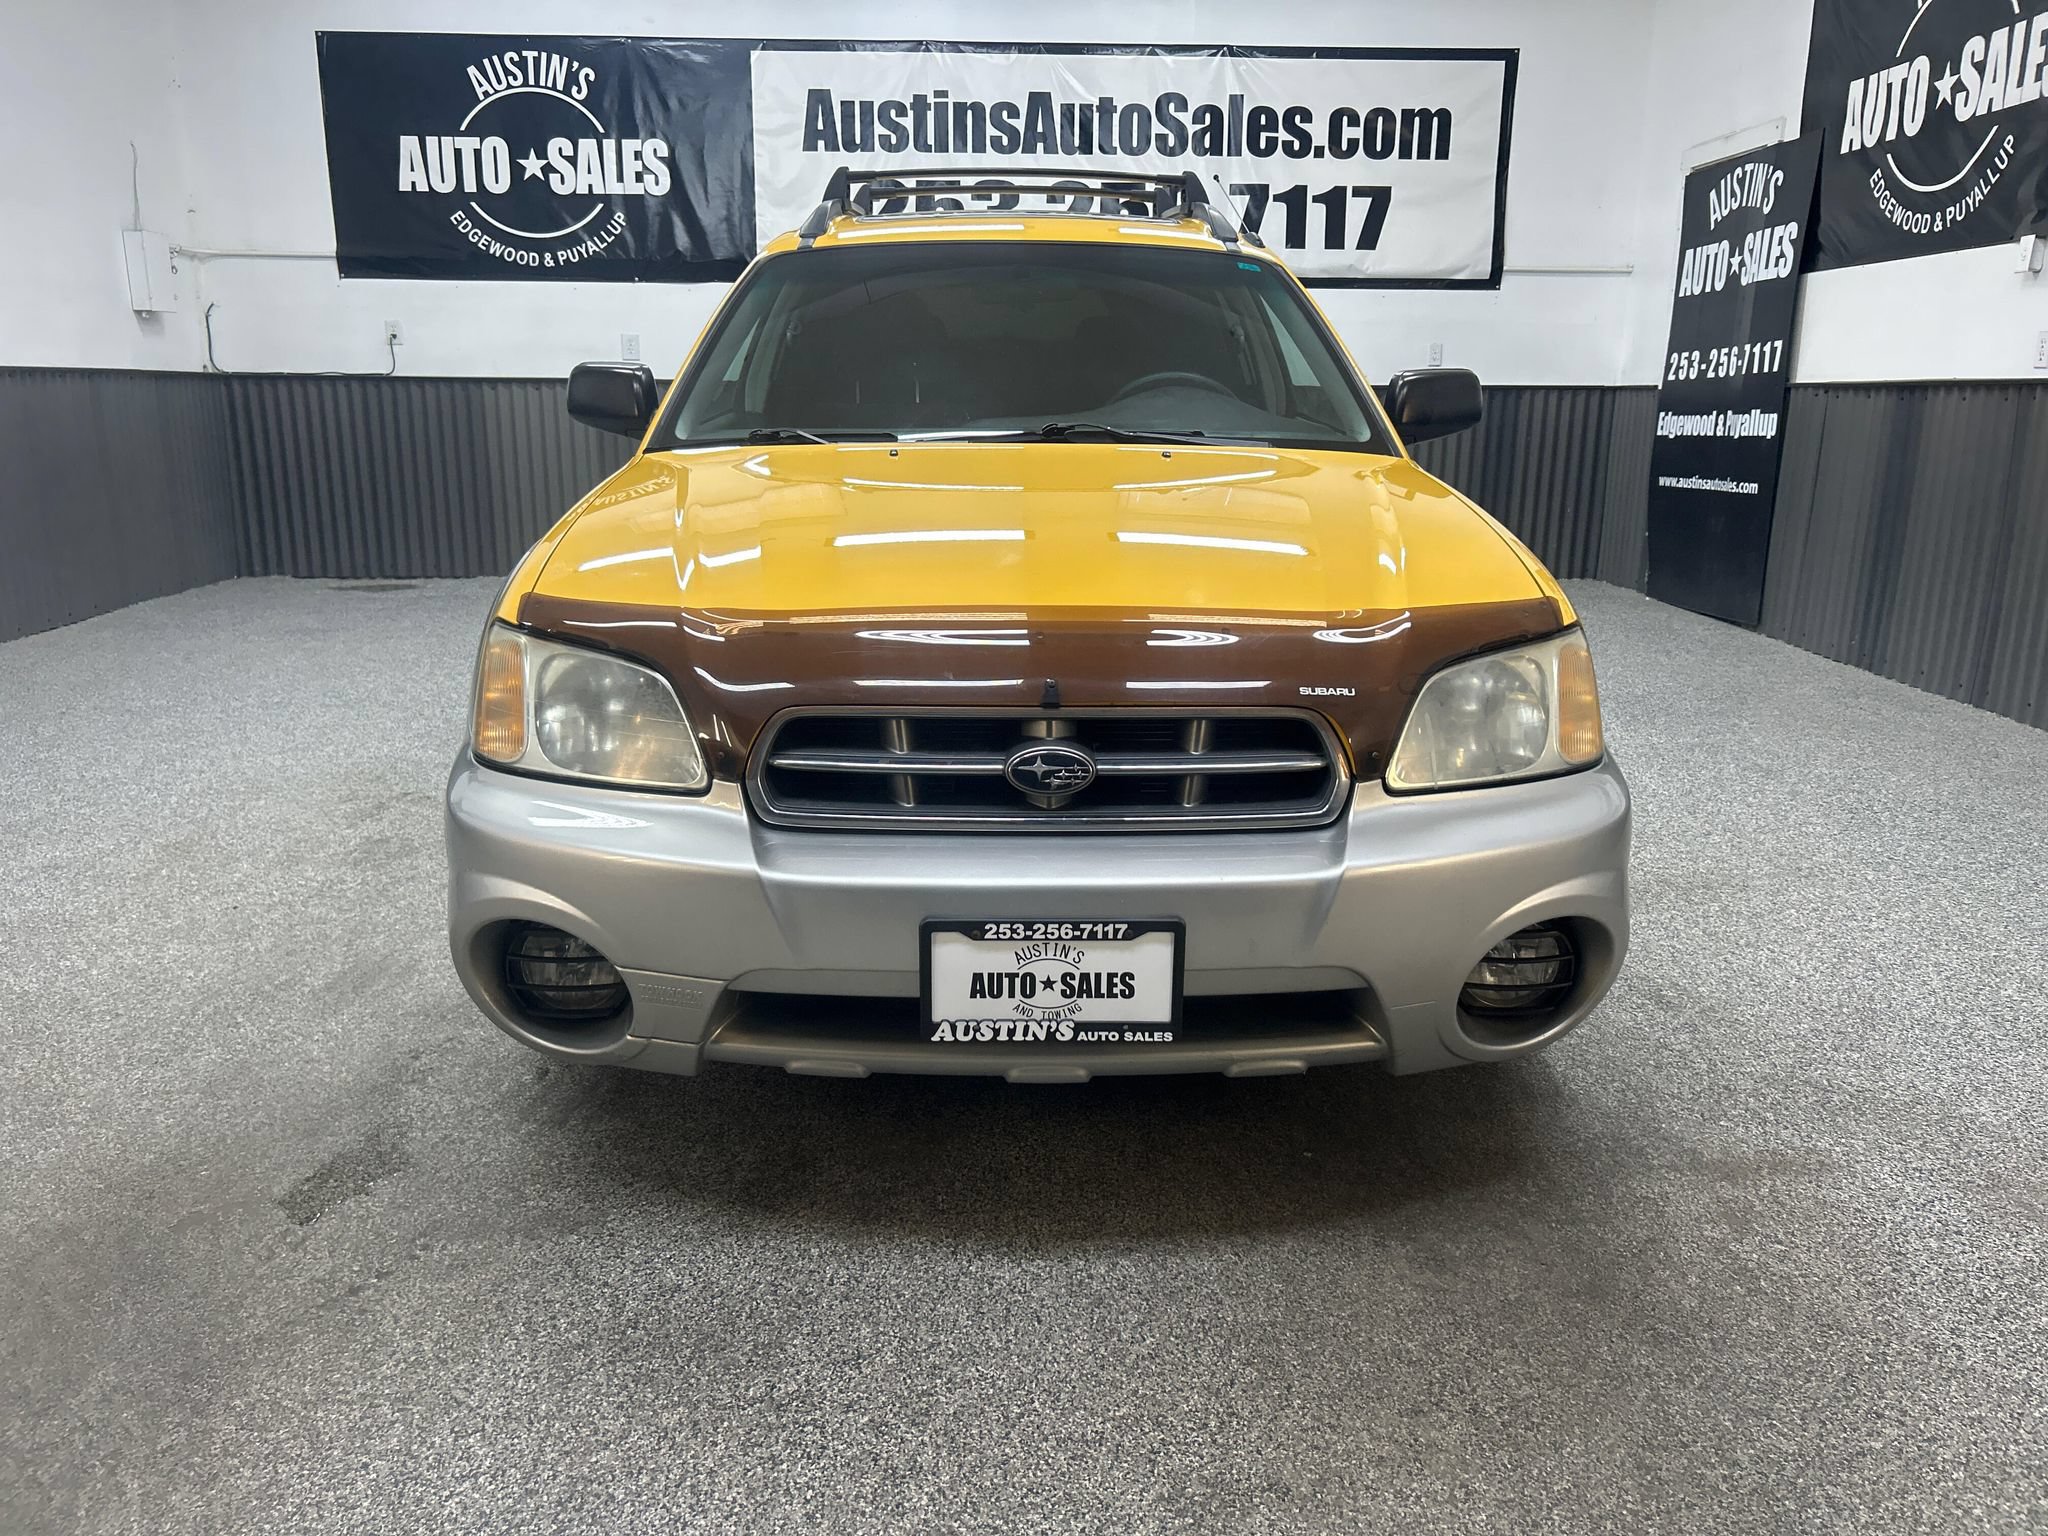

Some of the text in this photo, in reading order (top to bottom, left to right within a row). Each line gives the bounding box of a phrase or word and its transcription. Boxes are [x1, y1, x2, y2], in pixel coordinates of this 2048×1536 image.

[466, 50, 596, 101] AUSTIN'S
[1840, 11, 2048, 154] AUTO SALE
[801, 88, 1452, 162] AustinsAutoSales.com
[398, 135, 671, 196] AUTO SALES
[1869, 134, 2016, 234] EDGEWOOD & PUYALLUP
[1709, 163, 1784, 231] AUSTIN'S
[450, 209, 628, 267] EDGEWOOD & PUYALLUP
[1678, 221, 1799, 297] AUTO SALES
[1667, 339, 1784, 381] 253-256-7117
[1656, 409, 1778, 439] Edgewood & Puyallup
[1658, 475, 1758, 494] www.austinsautosales.com
[1299, 686, 1356, 696] SUBARU
[984, 923, 1129, 940] 253-256-7117
[1013, 942, 1085, 966] AUSTIN'S
[969, 971, 1135, 999] AUTO SALES
[931, 1019, 1173, 1042] AUSTIN'S AUTO SALES
[1012, 1003, 1083, 1020] AND TOWING
